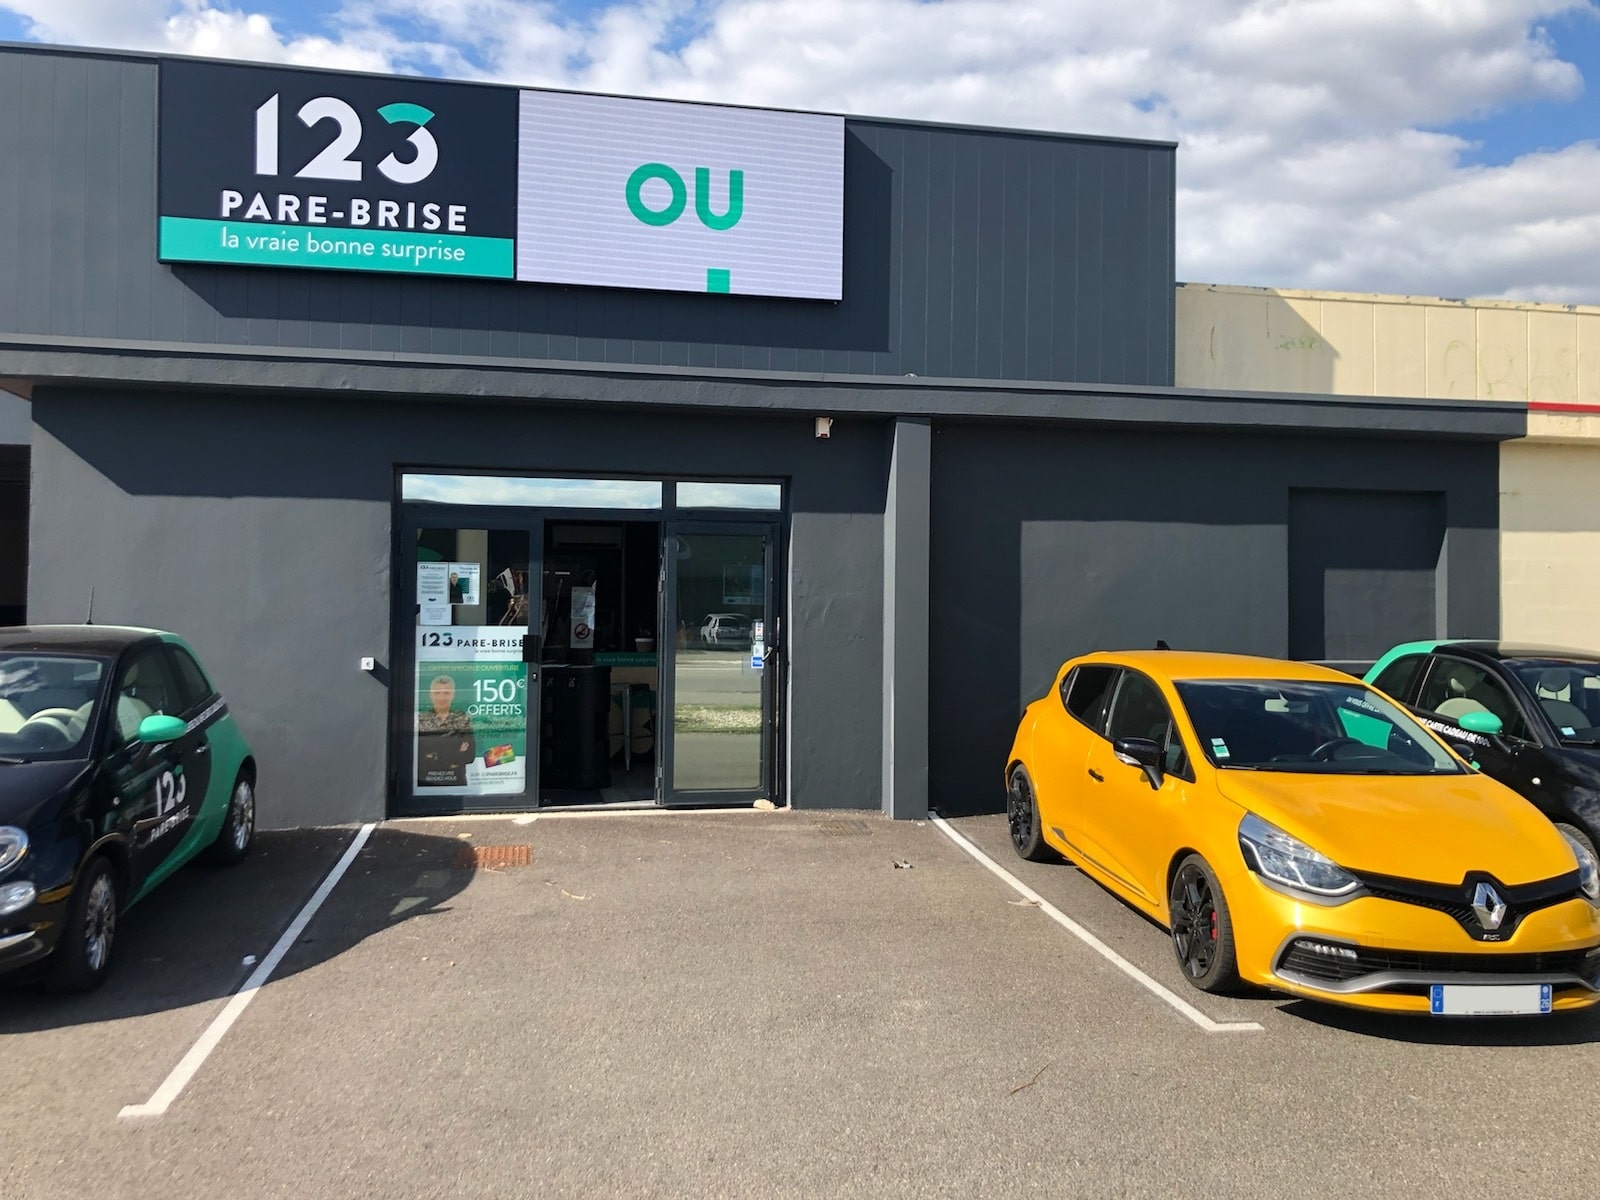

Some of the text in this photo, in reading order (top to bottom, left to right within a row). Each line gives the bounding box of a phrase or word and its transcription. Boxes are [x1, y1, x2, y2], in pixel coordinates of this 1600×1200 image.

[254, 93, 439, 184] 123
[221, 189, 467, 232] PARE-BRISE
[625, 162, 744, 231] OU
[221, 226, 466, 266] la vraie bonne surprise
[421, 632, 453, 647] 123
[467, 704, 522, 715] OFFERTS
[1443, 725, 1468, 740] CADEAU
[1466, 732, 1477, 743] DE
[156, 765, 187, 818] 123
[1541, 999, 1550, 1009] 26
